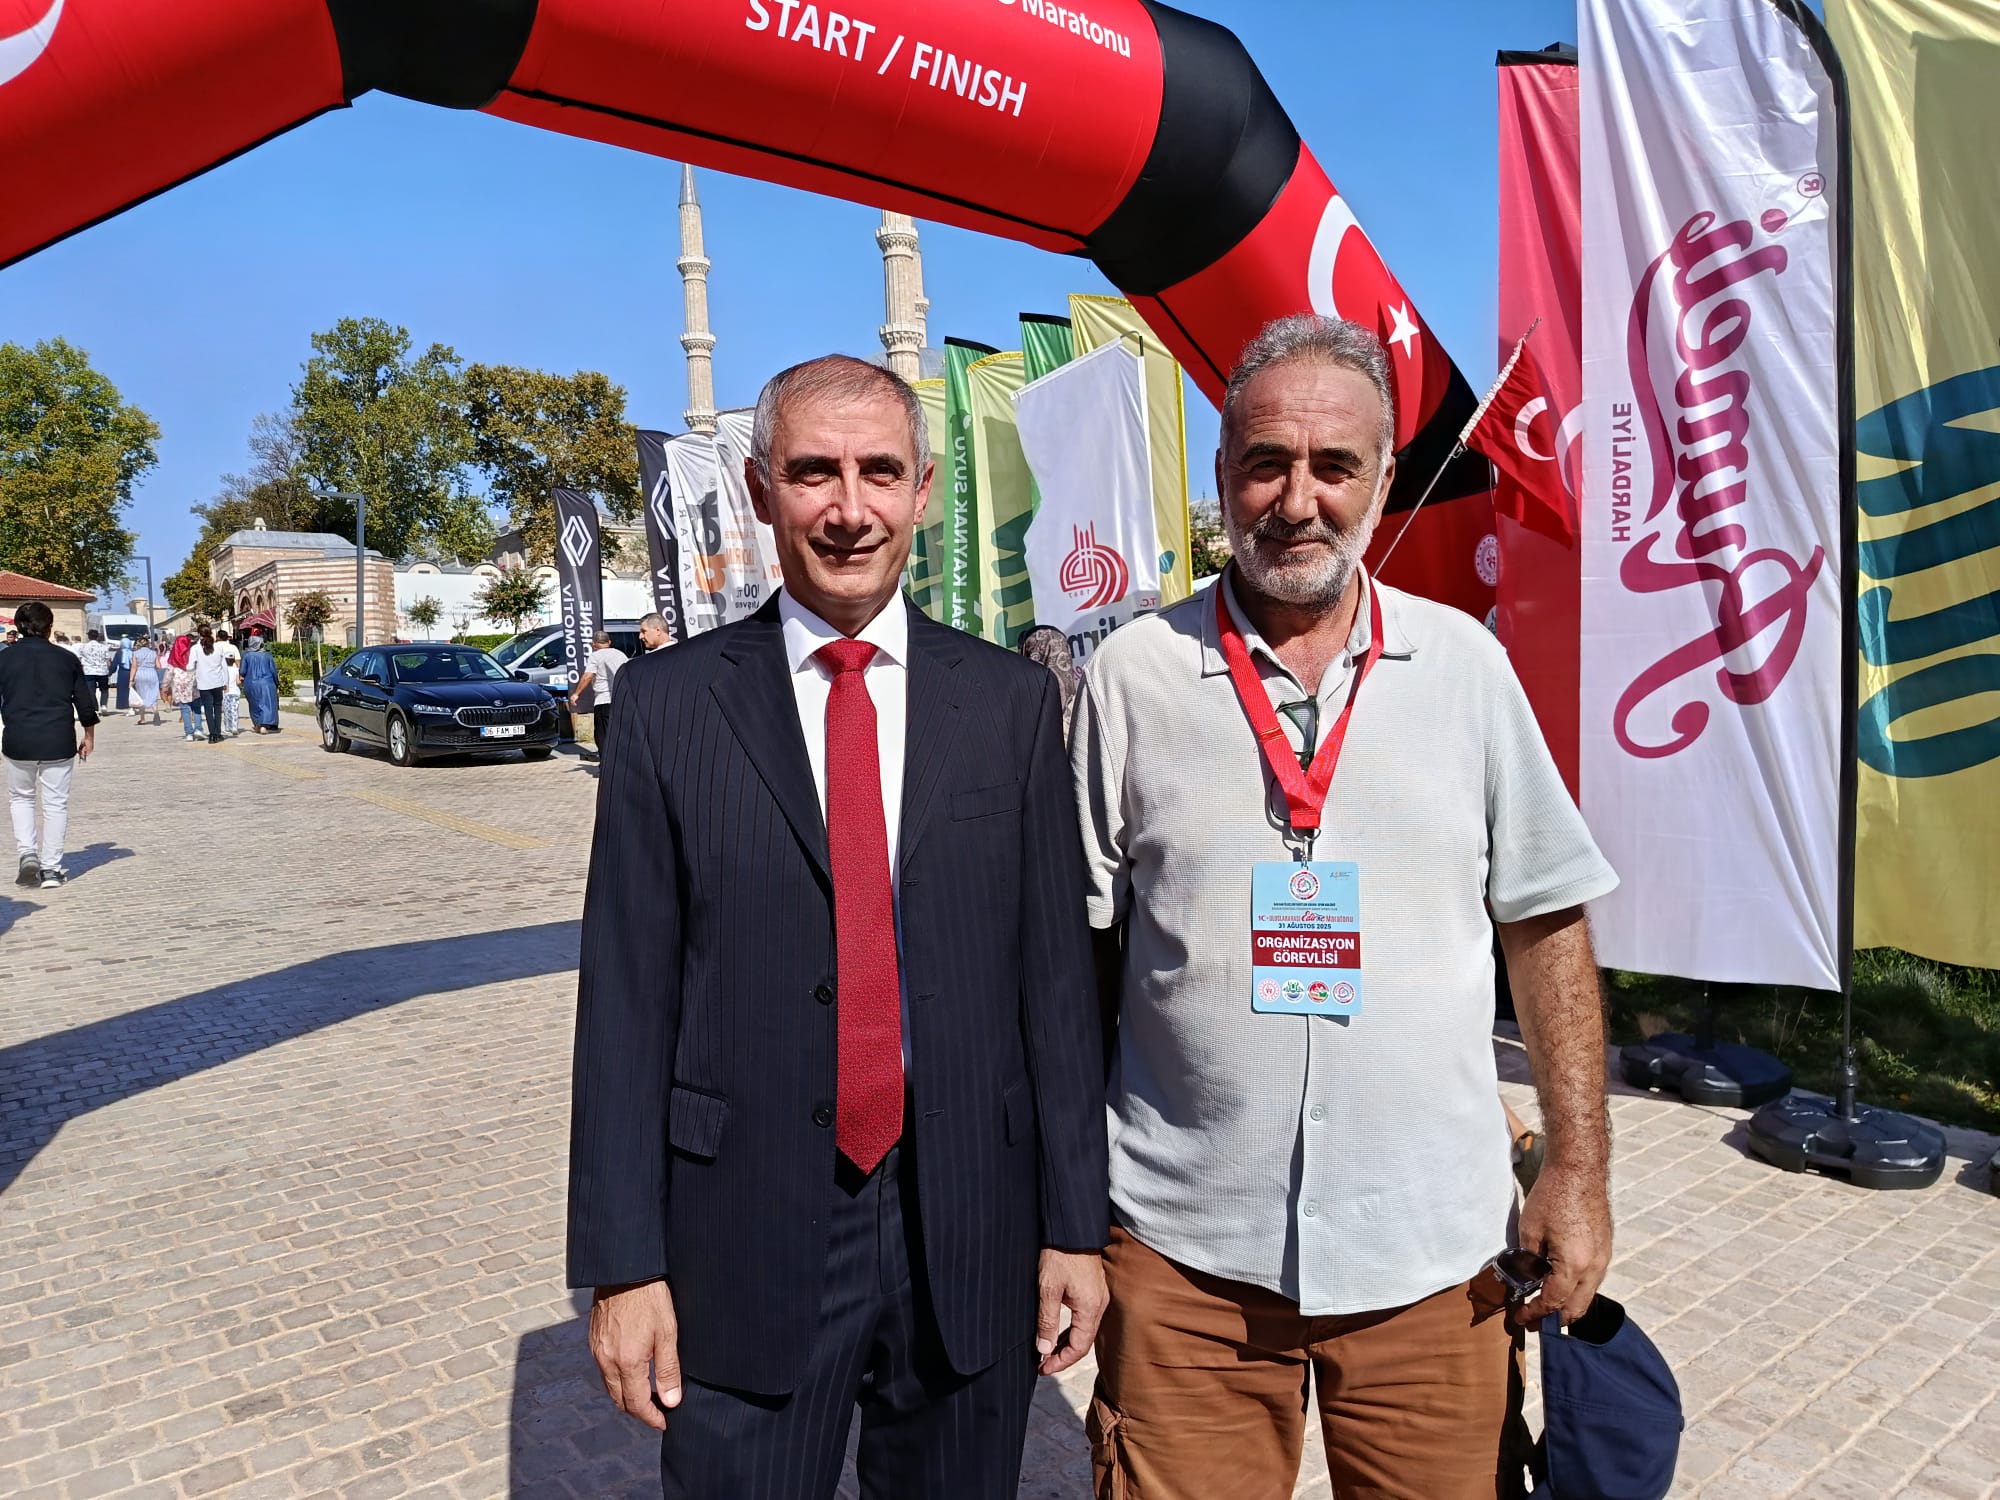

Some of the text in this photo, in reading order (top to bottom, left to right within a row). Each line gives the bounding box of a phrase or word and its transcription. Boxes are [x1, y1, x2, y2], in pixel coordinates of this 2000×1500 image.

[1022, 0, 1131, 58] Maratonu
[745, 0, 1027, 117] START / FINISH
[1287, 922, 1315, 930] AĞUSTOS
[1257, 935, 1355, 950] ORGANİZASYON
[1273, 950, 1338, 964] GÖREVLİSİ
